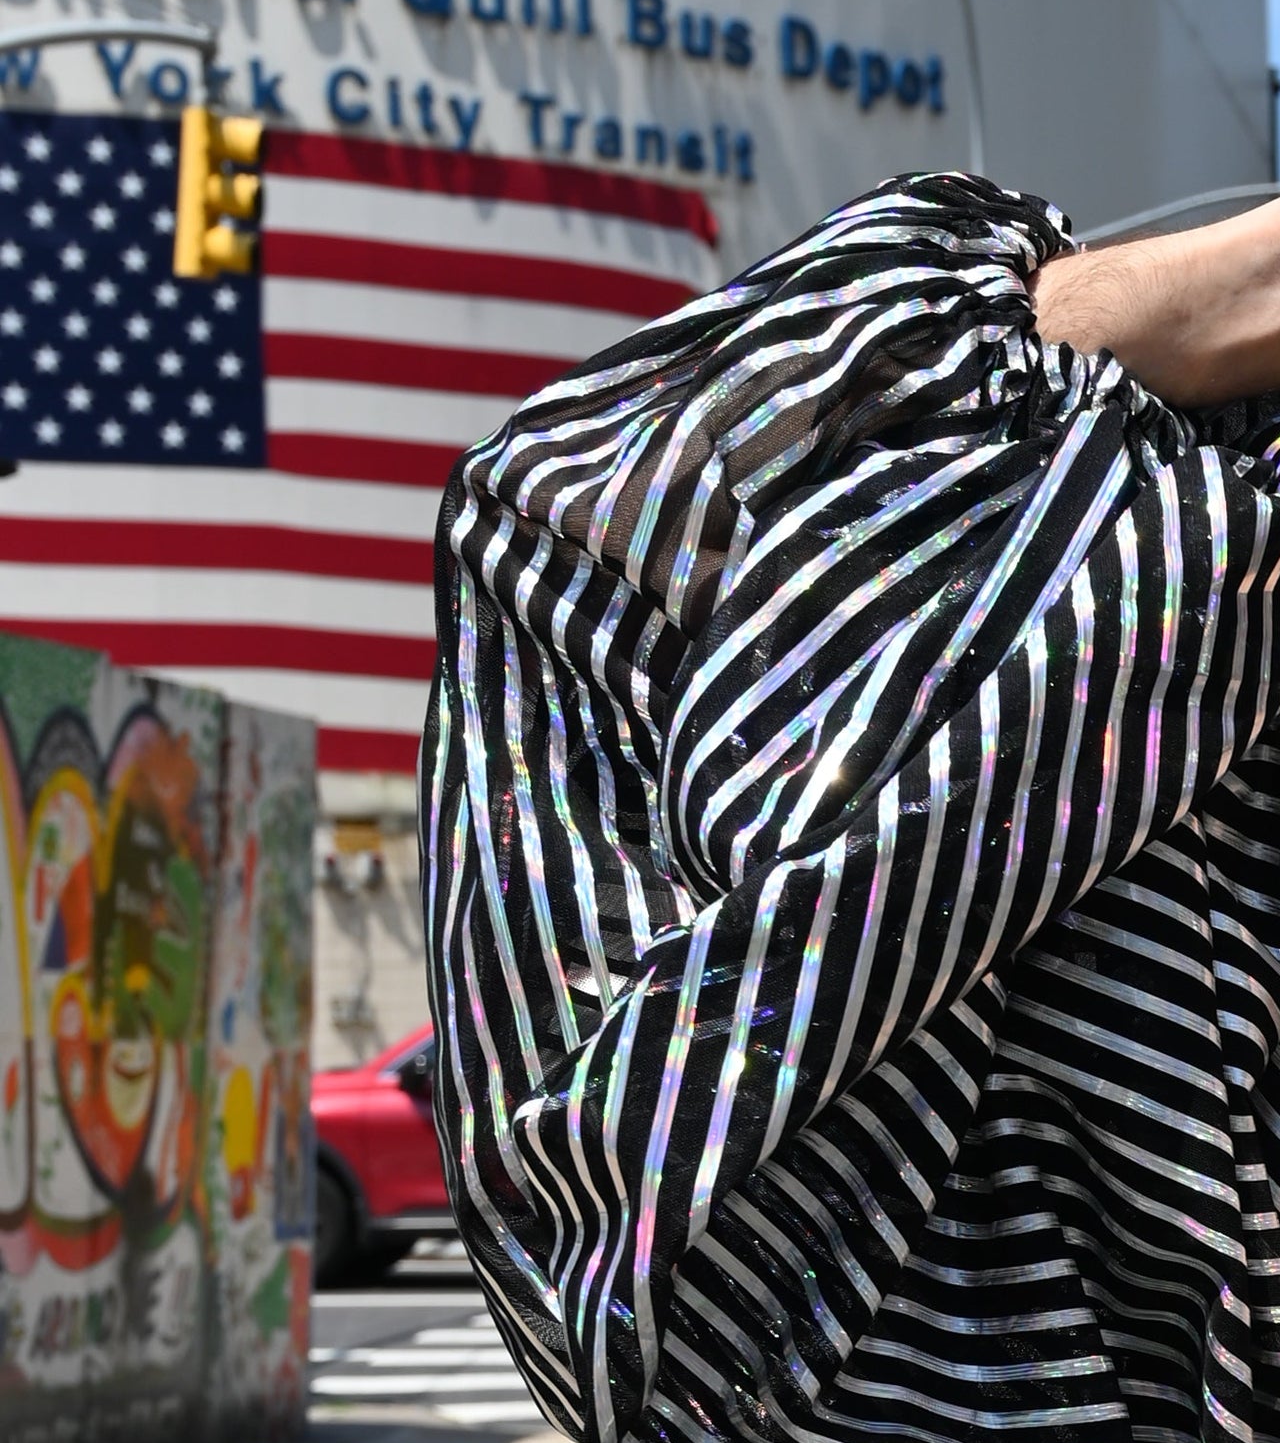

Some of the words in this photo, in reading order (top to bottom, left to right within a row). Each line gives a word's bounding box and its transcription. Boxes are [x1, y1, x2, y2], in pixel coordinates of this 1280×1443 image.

[96, 39, 284, 113] York
[326, 67, 482, 150] City
[518, 92, 755, 185] Transit
[779, 12, 947, 115] Depot
